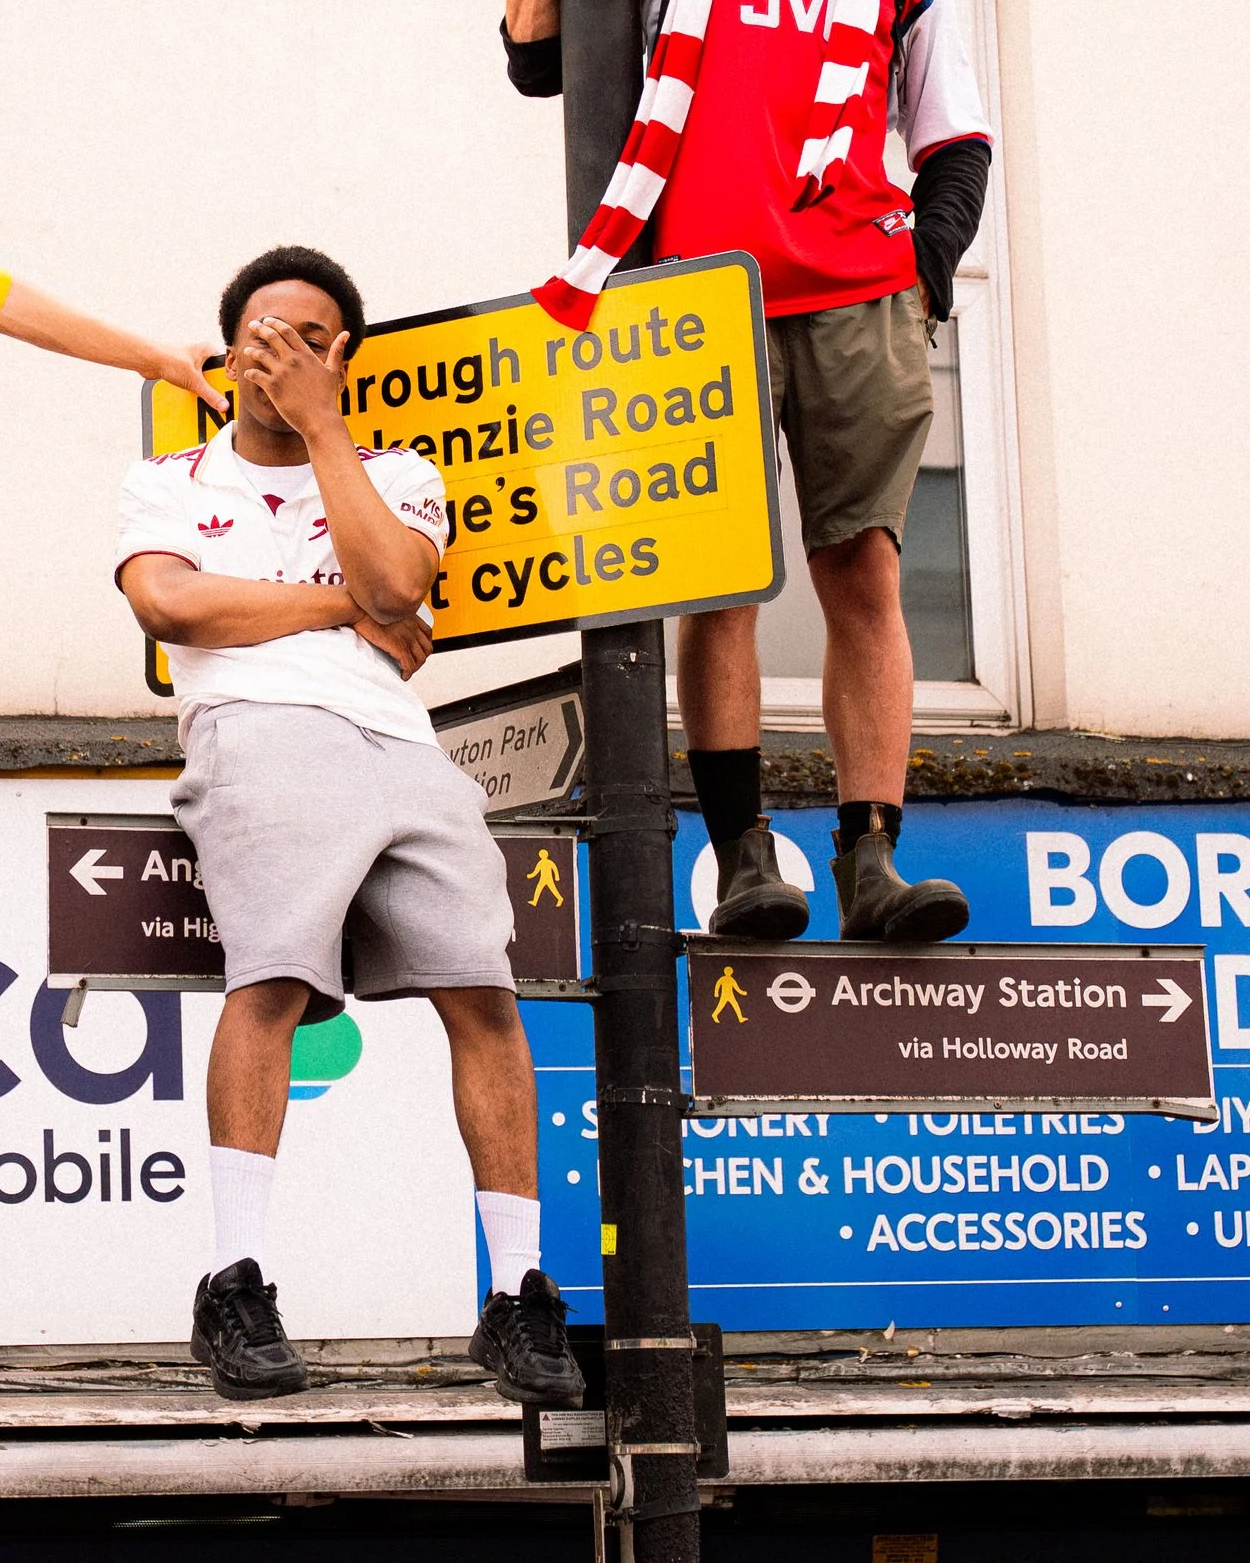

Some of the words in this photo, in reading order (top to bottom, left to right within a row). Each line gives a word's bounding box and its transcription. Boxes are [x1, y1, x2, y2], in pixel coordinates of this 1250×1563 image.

[546, 306, 705, 376] route
[582, 365, 734, 441] Road
[565, 441, 718, 516] Road
[471, 537, 659, 608] cycles
[501, 717, 549, 755] Park
[1025, 830, 1250, 929] BOR
[141, 916, 174, 937] via
[831, 975, 985, 1015] Archway
[998, 976, 1127, 1008] Station
[898, 1037, 933, 1059] via
[942, 1037, 1058, 1065] Holloway
[1068, 1038, 1128, 1060] Road
[798, 1157, 830, 1195] &
[843, 1153, 1110, 1195] HOUSEHOLD
[1176, 1153, 1250, 1191] LAP
[866, 1211, 1148, 1252] ACCESSORIES
[1214, 1210, 1250, 1249] U
